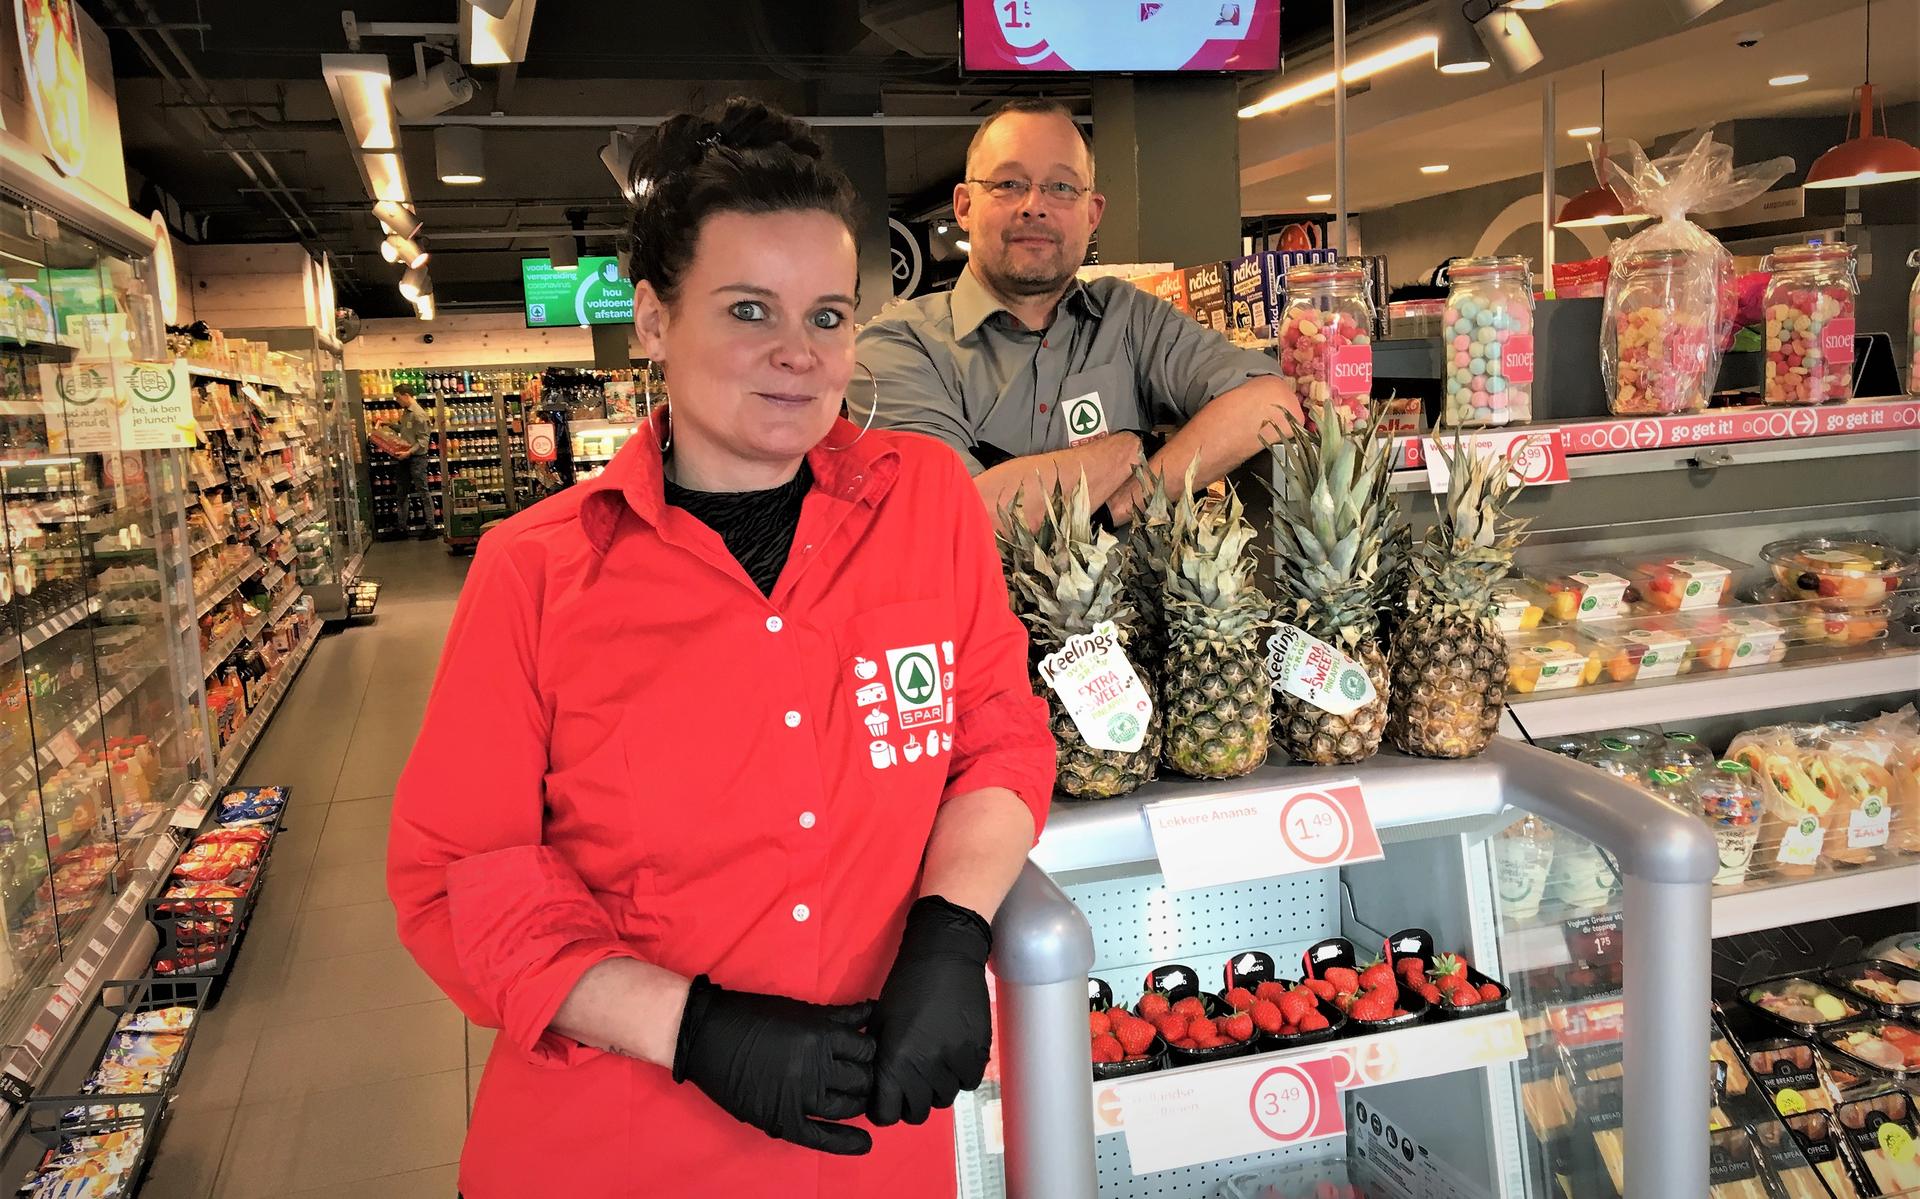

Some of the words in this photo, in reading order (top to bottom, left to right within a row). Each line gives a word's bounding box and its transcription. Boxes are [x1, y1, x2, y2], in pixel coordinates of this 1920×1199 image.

[527, 272, 578, 281] verspreiding
[527, 282, 571, 290] coronavirus
[602, 288, 622, 297] hou
[587, 299, 634, 309] voldoend
[594, 309, 633, 319] afstand
[1335, 362, 1373, 382] snoep
[150, 405, 160, 414] ik
[161, 404, 181, 413] ben
[133, 416, 143, 427] je
[144, 415, 177, 425] lunch!
[1826, 415, 1844, 430] go
[1845, 412, 1870, 428] get
[1870, 410, 1884, 424] it!
[1672, 427, 1690, 442] go
[1691, 424, 1716, 440] get
[1717, 419, 1733, 435] it!
[1517, 448, 1541, 466] 8.99
[1043, 633, 1114, 682] Keelings
[902, 708, 941, 724] SPAR
[1159, 813, 1209, 829] Lekkere
[1211, 806, 1258, 822] Ananas
[1295, 812, 1333, 840] 1.49
[1764, 1078, 1776, 1087] THE
[1776, 1075, 1794, 1085] BREAD
[1795, 1073, 1816, 1083] OFFICE
[1264, 1087, 1301, 1116] 3.49
[1857, 1133, 1870, 1142] THE
[1807, 1144, 1830, 1156] OFFICE
[1709, 1165, 1728, 1175] READ
